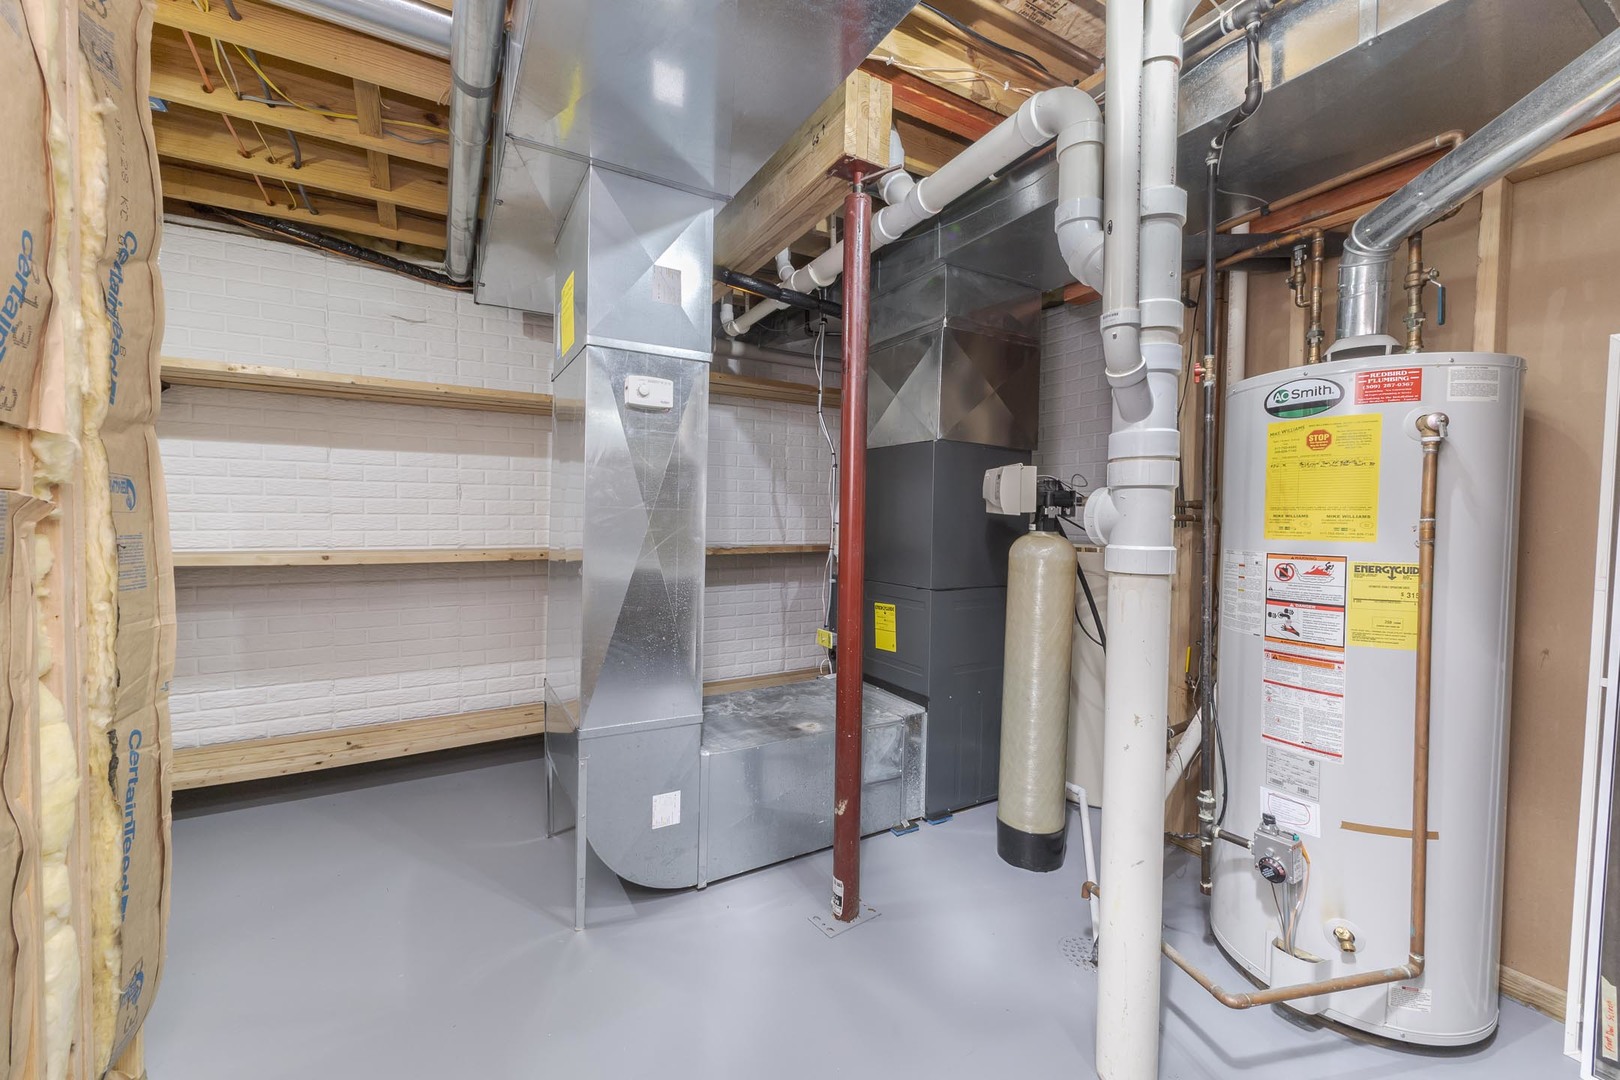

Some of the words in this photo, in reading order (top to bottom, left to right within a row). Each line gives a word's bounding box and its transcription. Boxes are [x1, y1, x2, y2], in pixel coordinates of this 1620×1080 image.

[0, 230, 35, 364] Certain
[108, 231, 138, 377] Certaineed
[1367, 376, 1409, 384] PLUMBING
[1291, 385, 1332, 399] Smith
[1308, 433, 1330, 442] STOP
[1353, 564, 1419, 575] ENERGYGUID
[122, 729, 143, 892] CertainTeed
